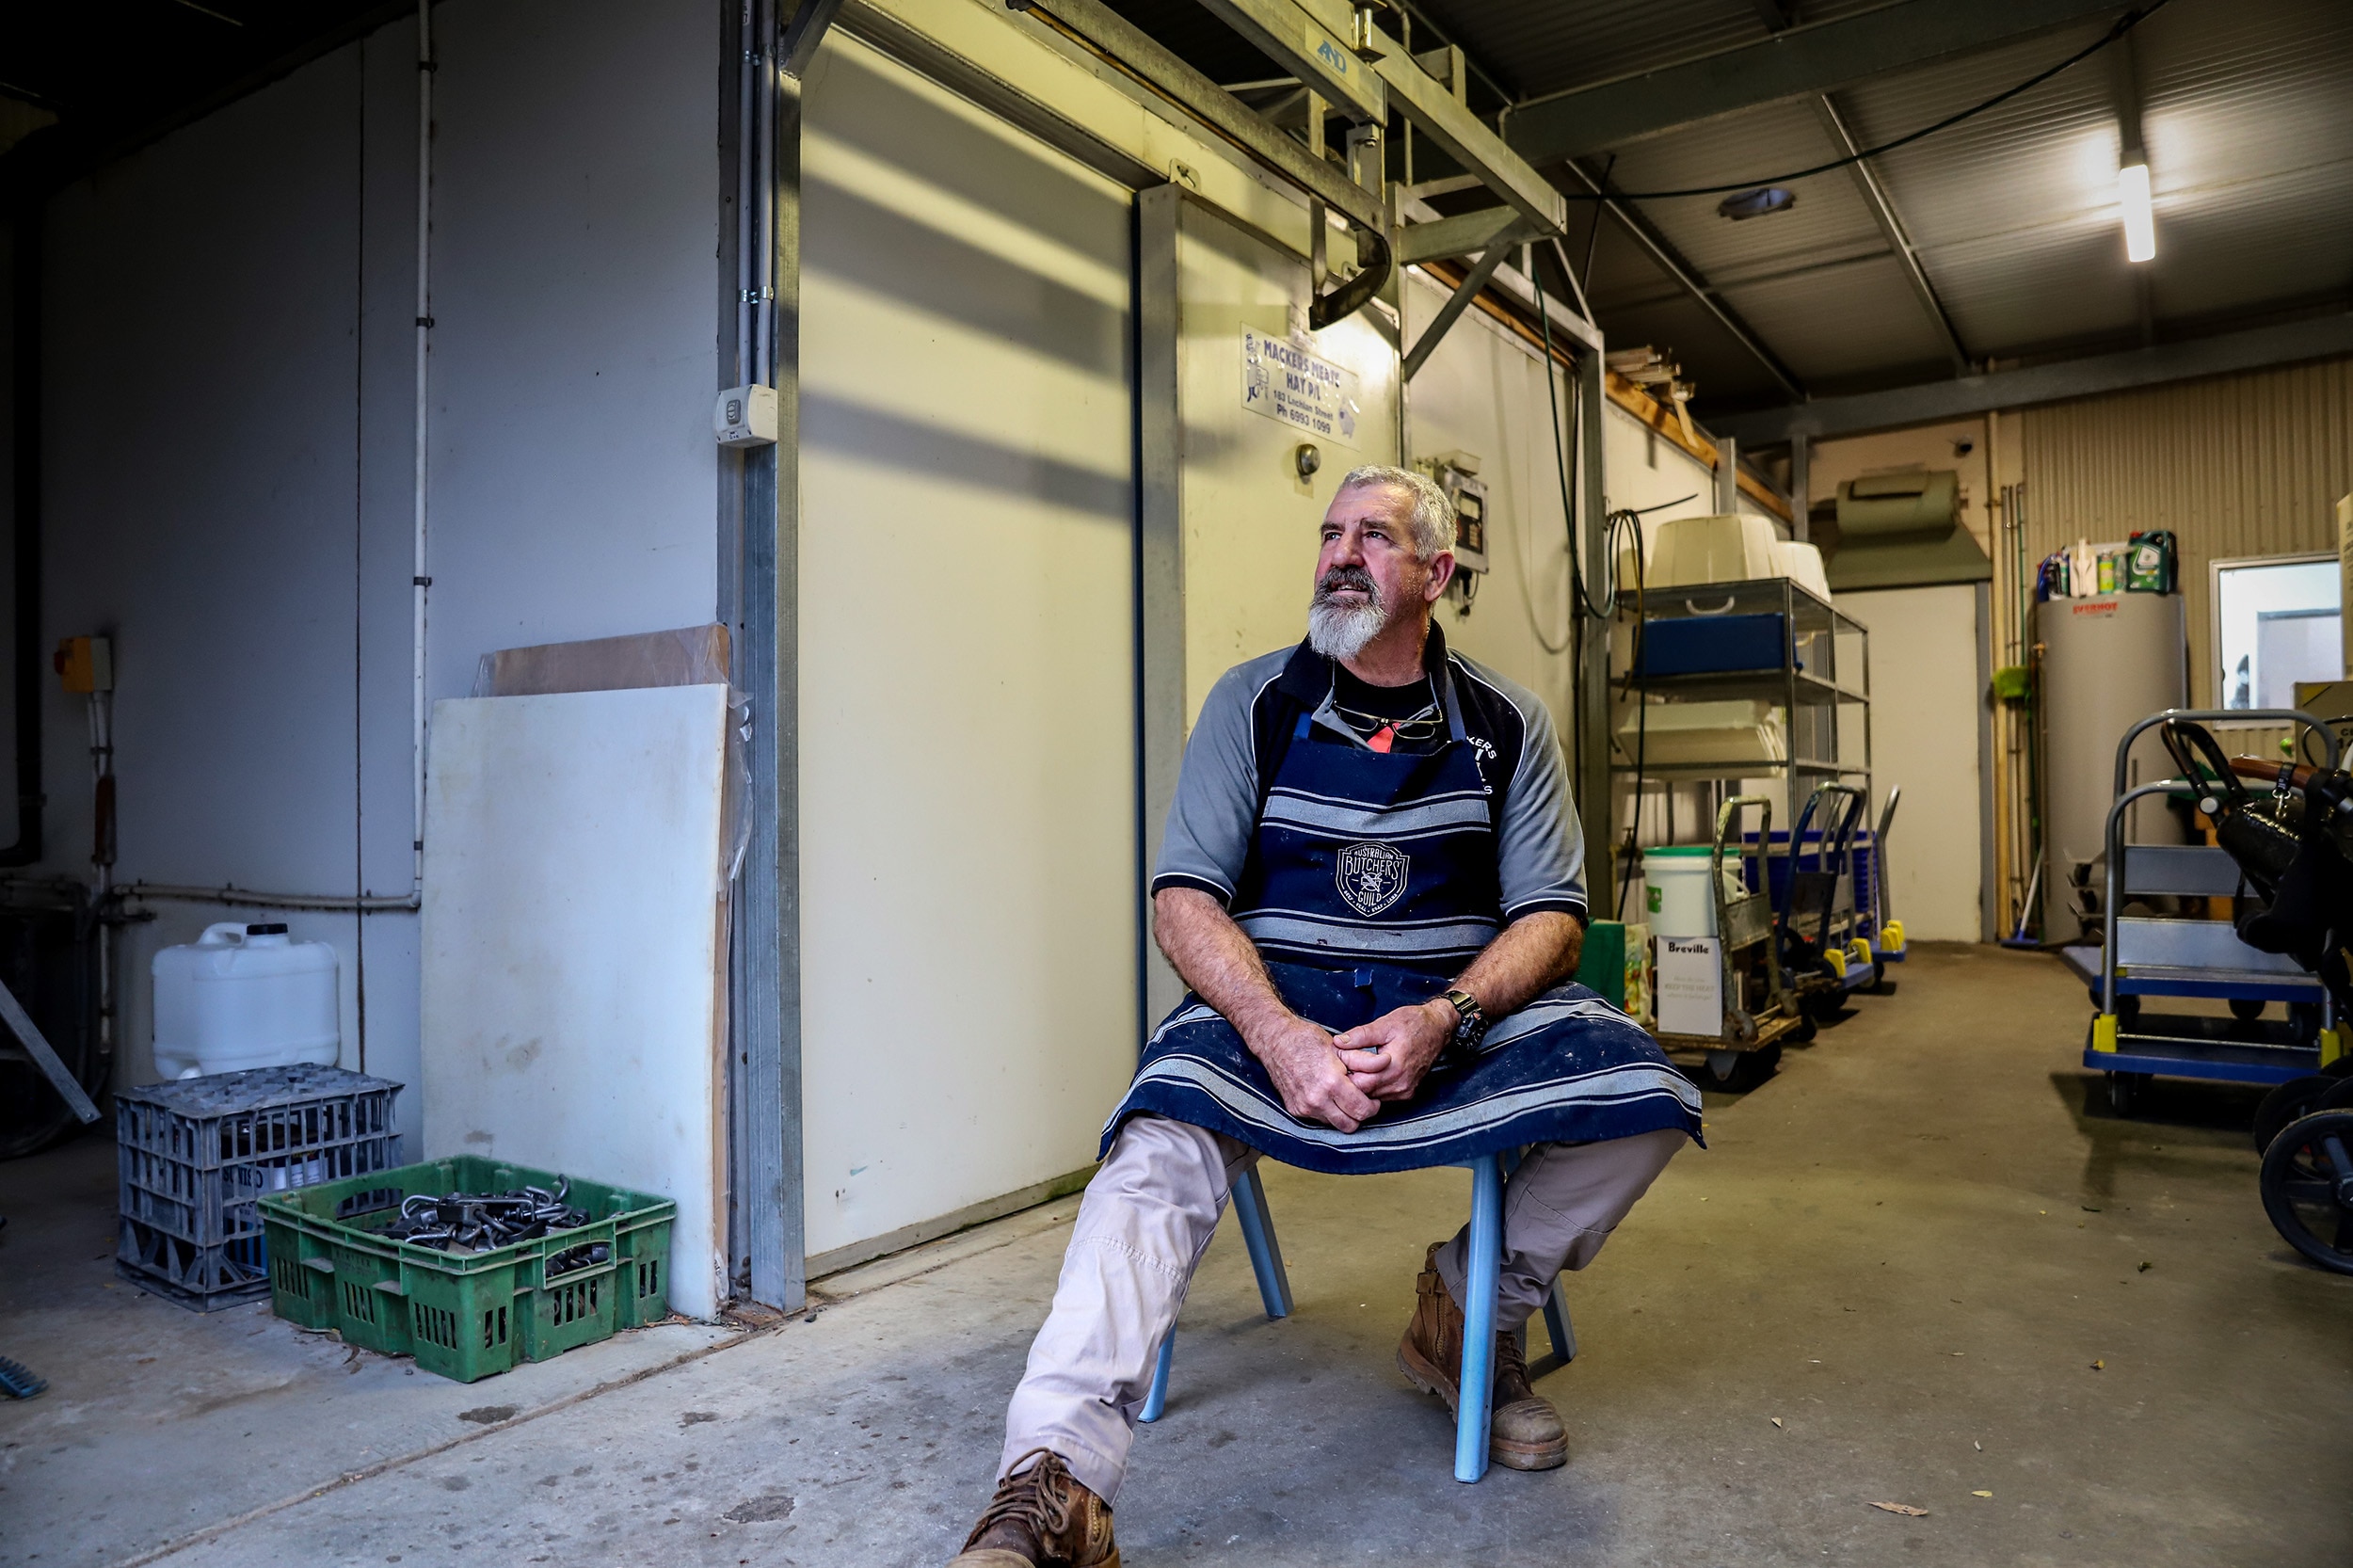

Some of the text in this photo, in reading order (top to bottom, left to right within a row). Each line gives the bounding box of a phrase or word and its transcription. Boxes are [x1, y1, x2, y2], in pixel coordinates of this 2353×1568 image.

[1264, 340, 1339, 388] MACKERS MEATS
[1287, 372, 1306, 394] HAY
[1273, 390, 1334, 421] 183 Lachlan Street
[1276, 403, 1331, 434] Ph 6993 1099
[1353, 847, 1394, 860] AUSTRALIAN
[1357, 891, 1382, 907] GUILD
[1668, 941, 1709, 953] Breville
